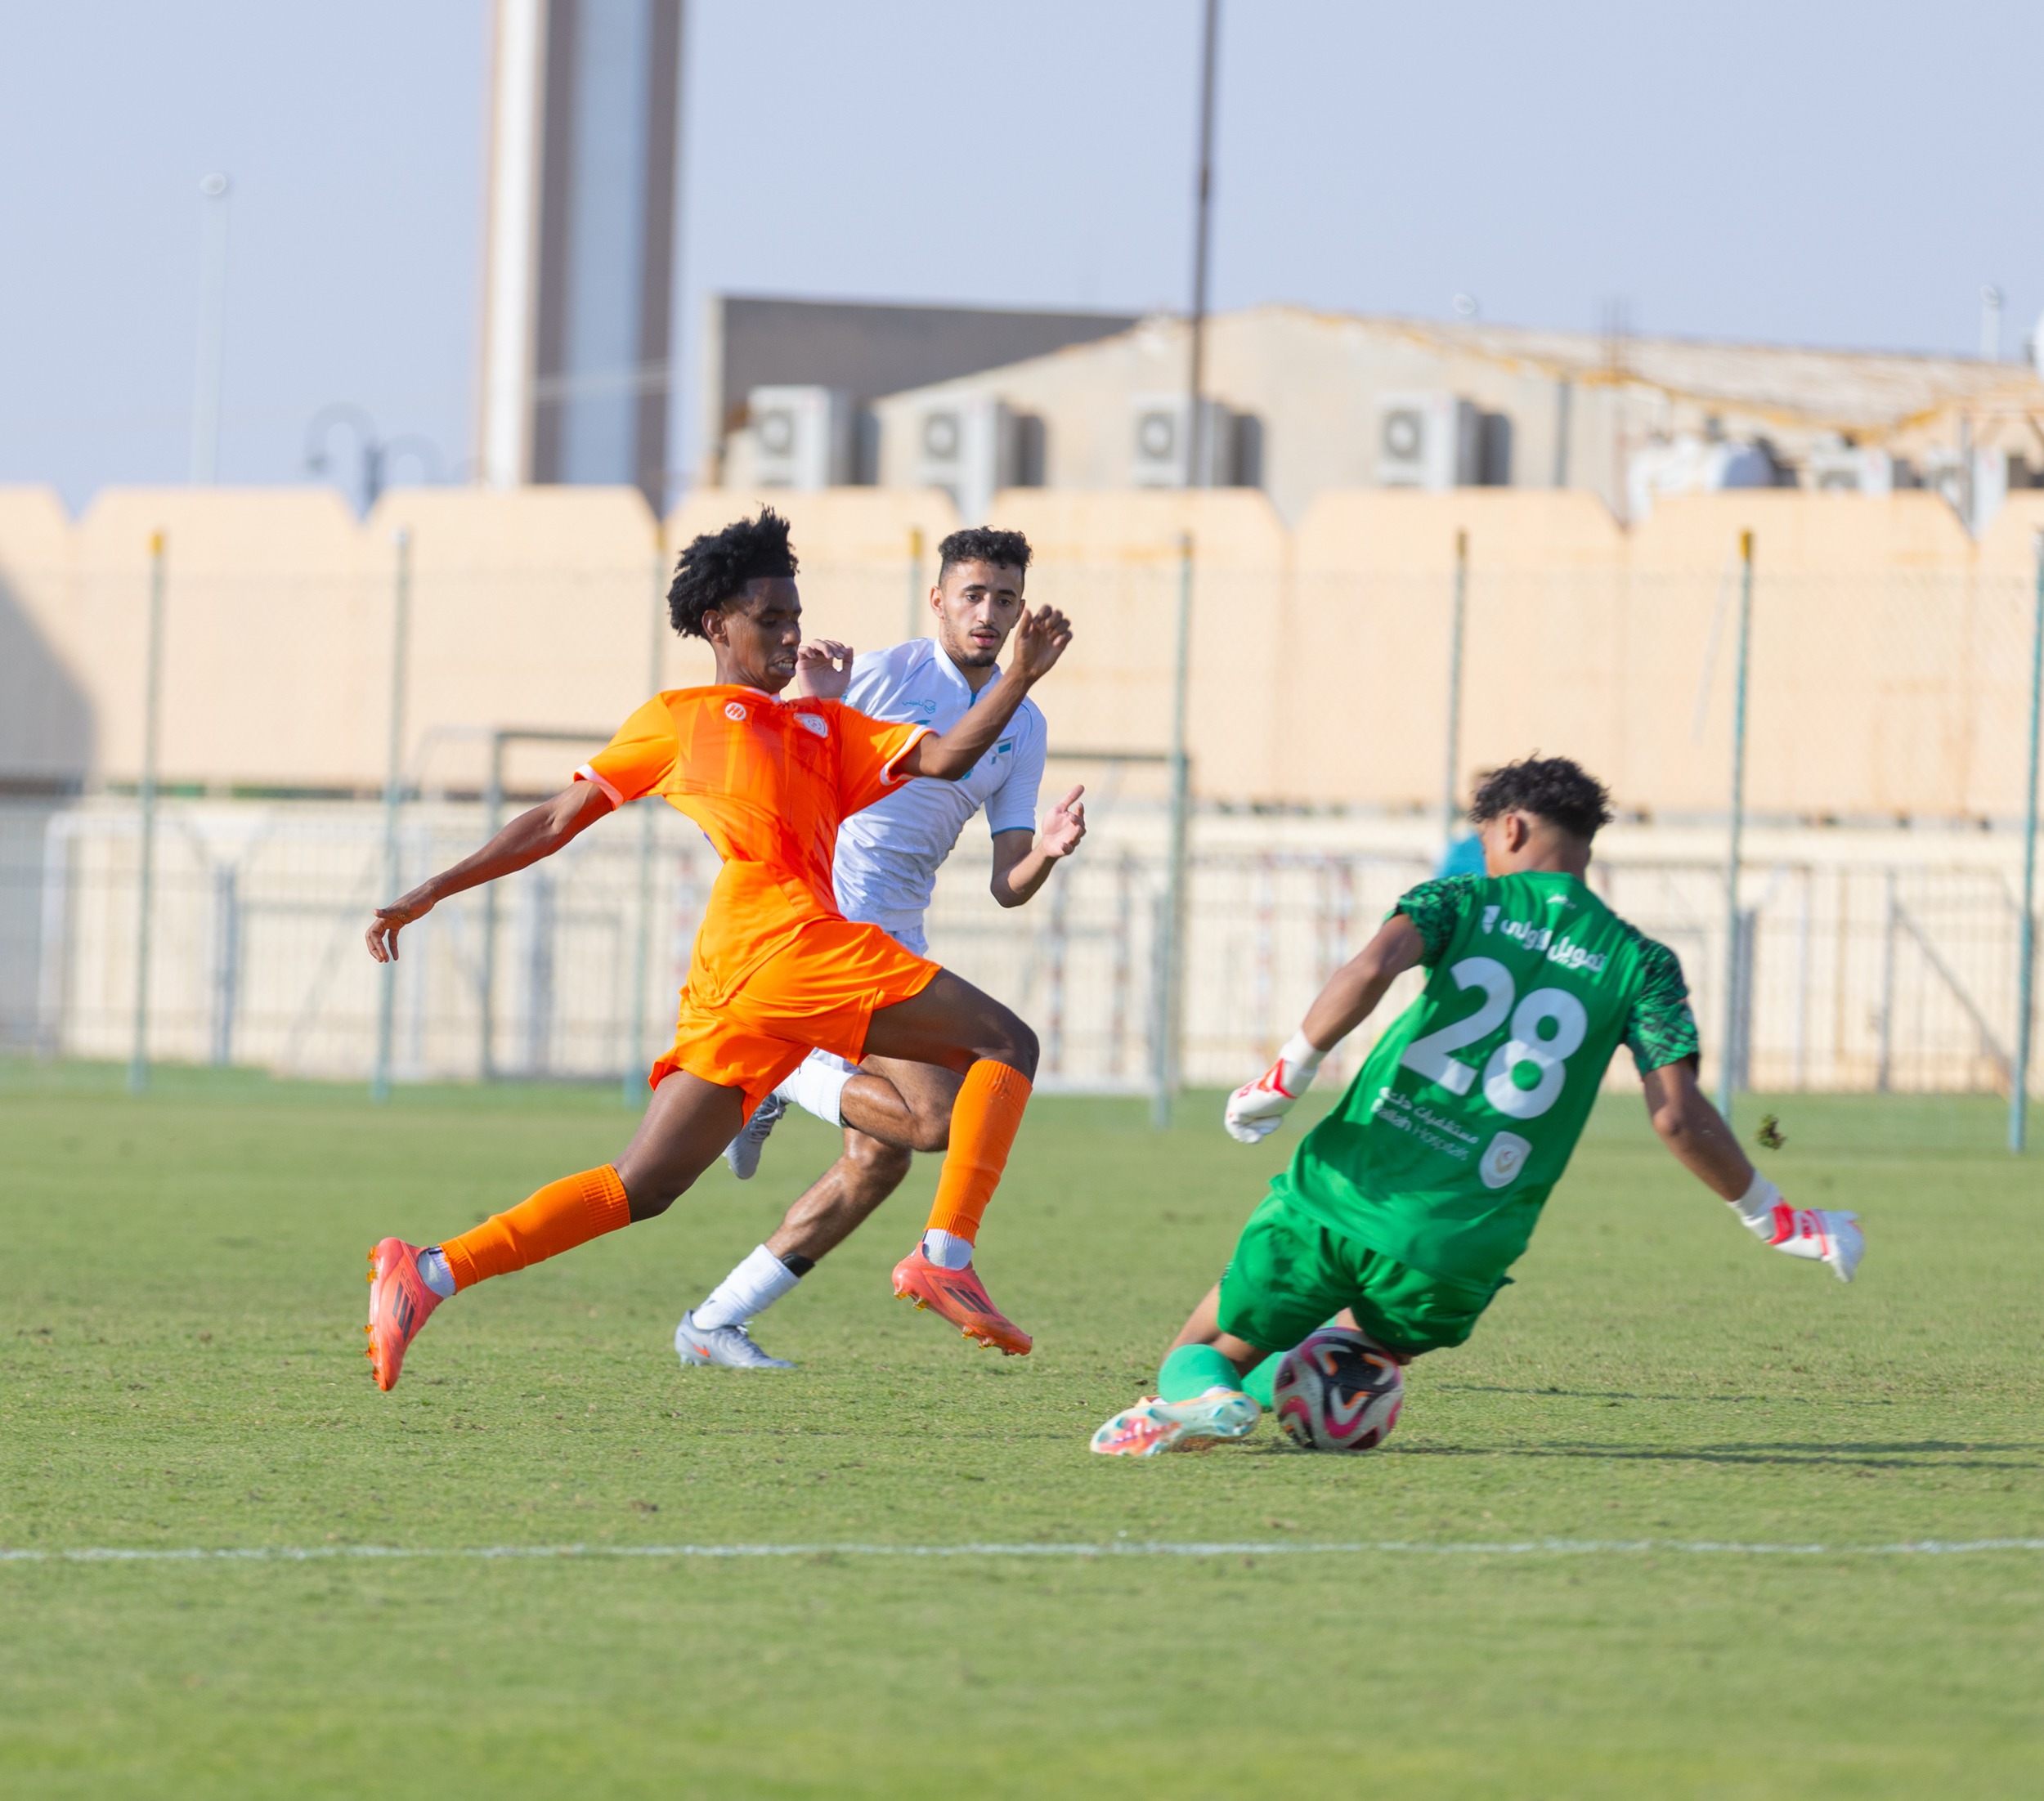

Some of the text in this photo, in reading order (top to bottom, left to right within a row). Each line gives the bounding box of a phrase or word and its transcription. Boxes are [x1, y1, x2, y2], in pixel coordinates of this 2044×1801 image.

[1546, 936, 1607, 973] تمويل
[1401, 957, 1588, 1120] 28
[1412, 1123, 1470, 1161] Hospitals
